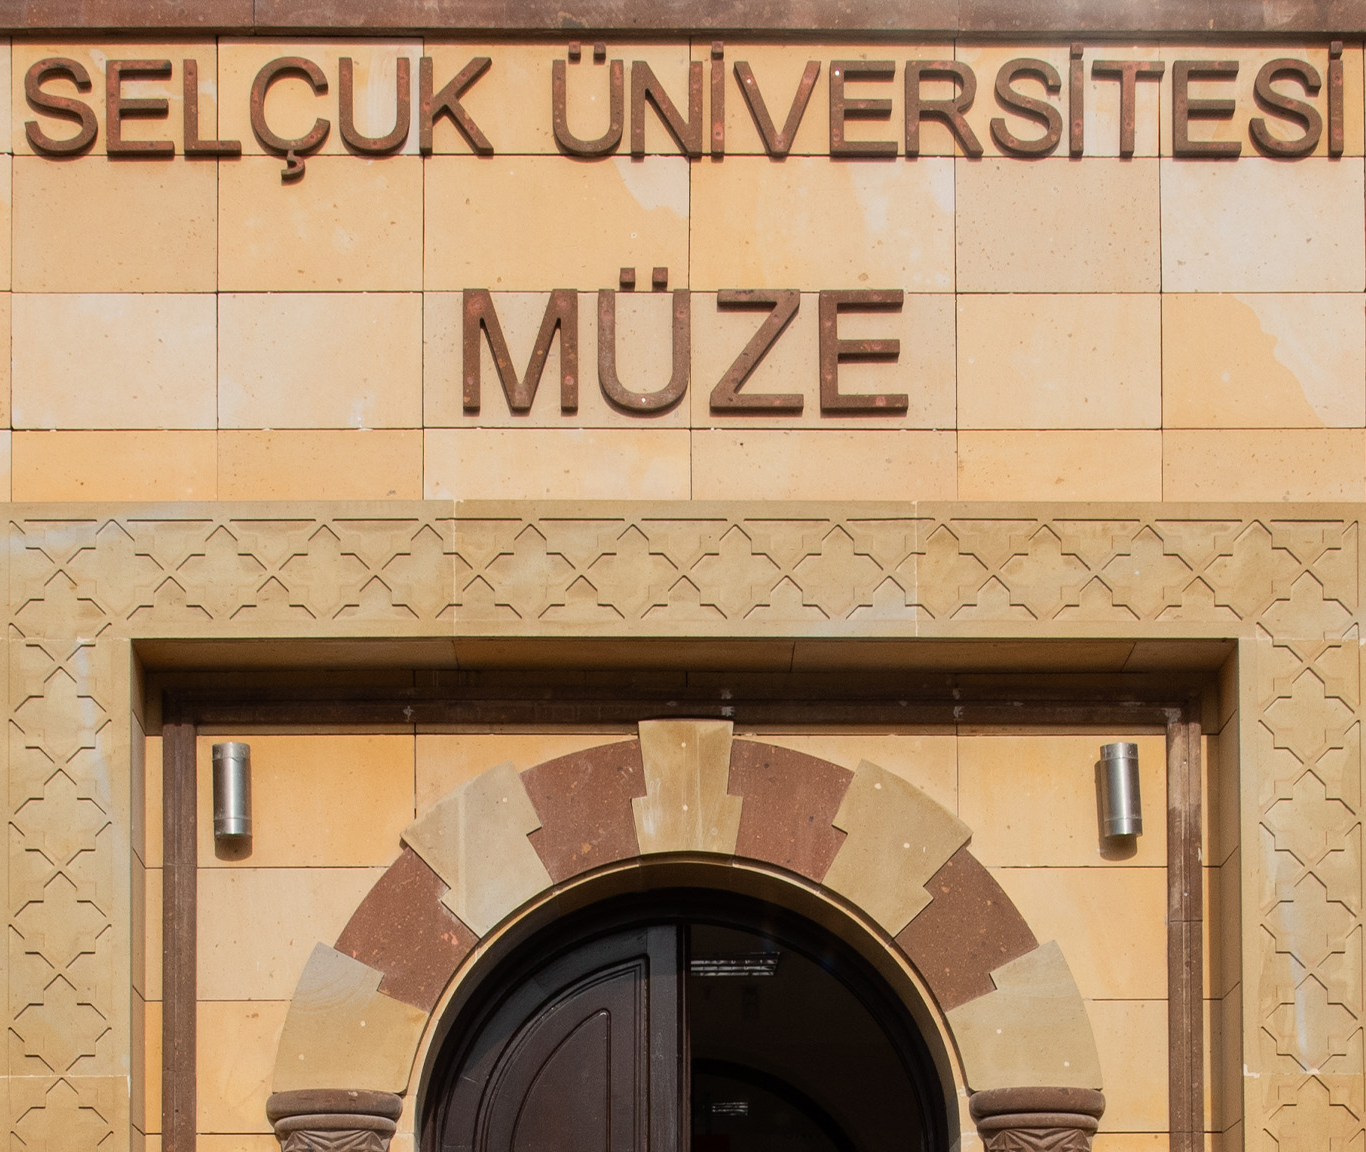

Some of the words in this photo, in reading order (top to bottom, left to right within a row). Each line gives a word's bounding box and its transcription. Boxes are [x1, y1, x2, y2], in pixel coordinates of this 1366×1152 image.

[23, 55, 495, 184] SELÇUK
[551, 41, 1349, 161] ÜNİVERSİTESİ
[460, 266, 910, 416] MÜZE
